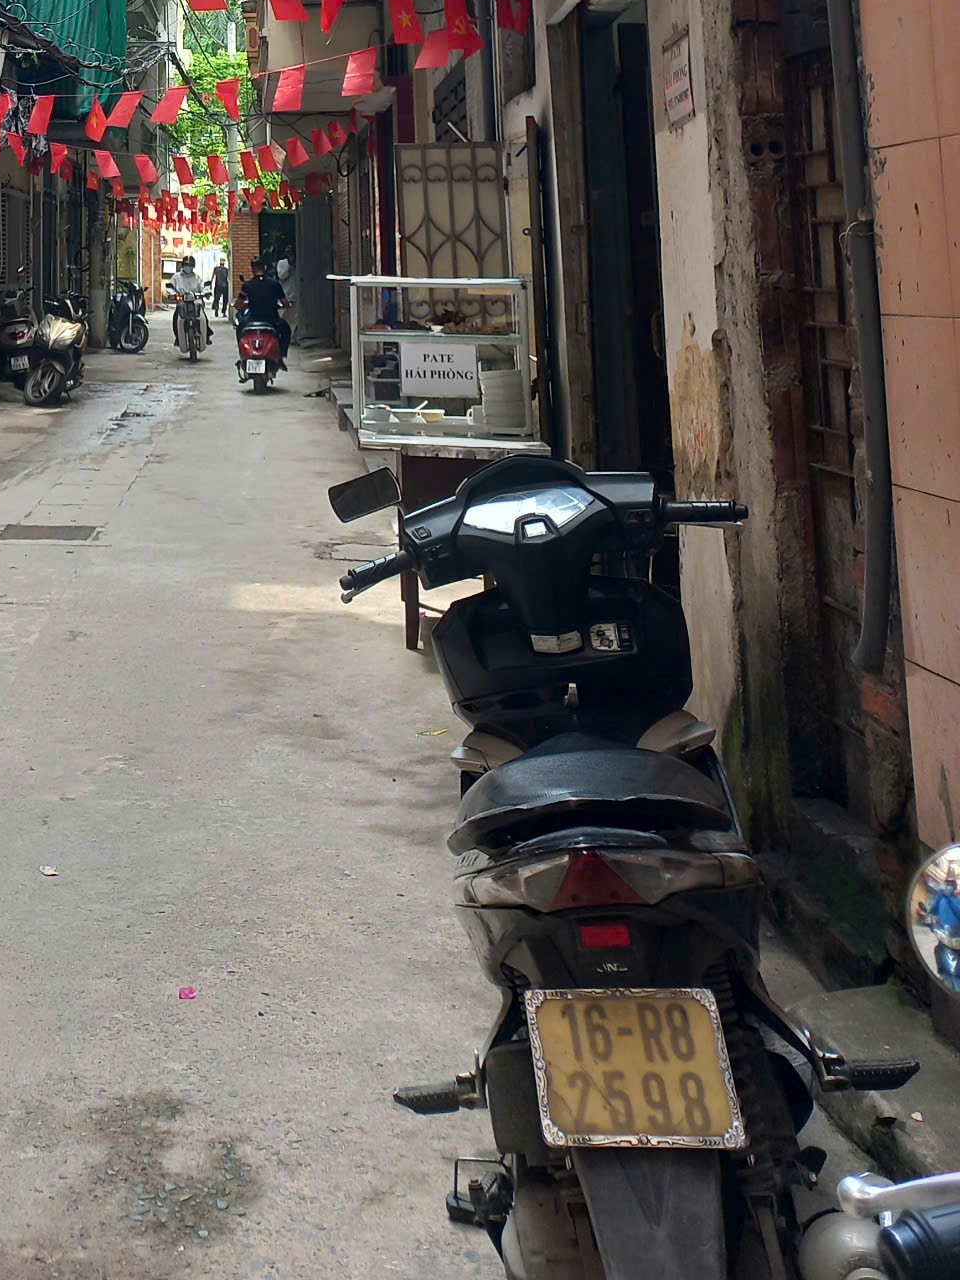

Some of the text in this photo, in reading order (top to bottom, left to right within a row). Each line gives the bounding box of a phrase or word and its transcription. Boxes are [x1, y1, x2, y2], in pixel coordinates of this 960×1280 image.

[405, 366, 474, 381] HẢI PHÒNG
[423, 353, 455, 363] PATE
[561, 1002, 696, 1063] 16-R8
[568, 1072, 712, 1135] 2598
